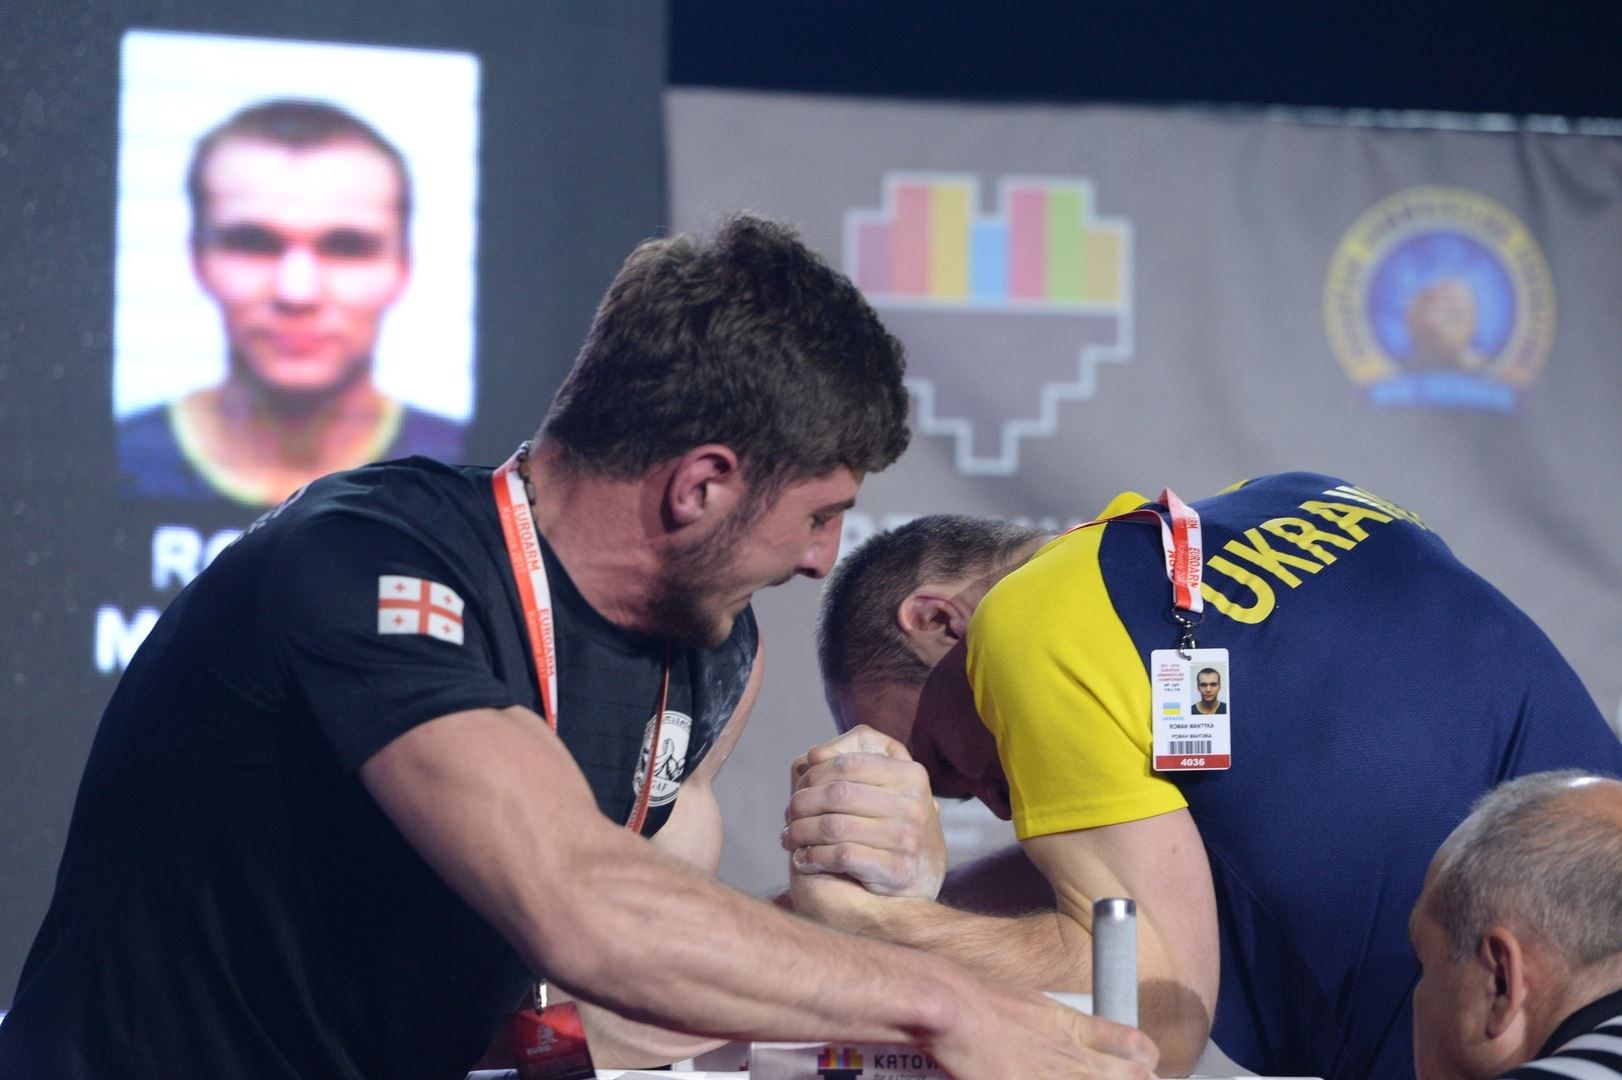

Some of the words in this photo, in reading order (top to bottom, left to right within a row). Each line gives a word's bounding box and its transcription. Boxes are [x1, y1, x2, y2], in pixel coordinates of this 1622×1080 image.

[514, 503, 540, 571] EUROARM
[540, 608, 556, 676] EUROARM
[1180, 758, 1205, 767] 4036
